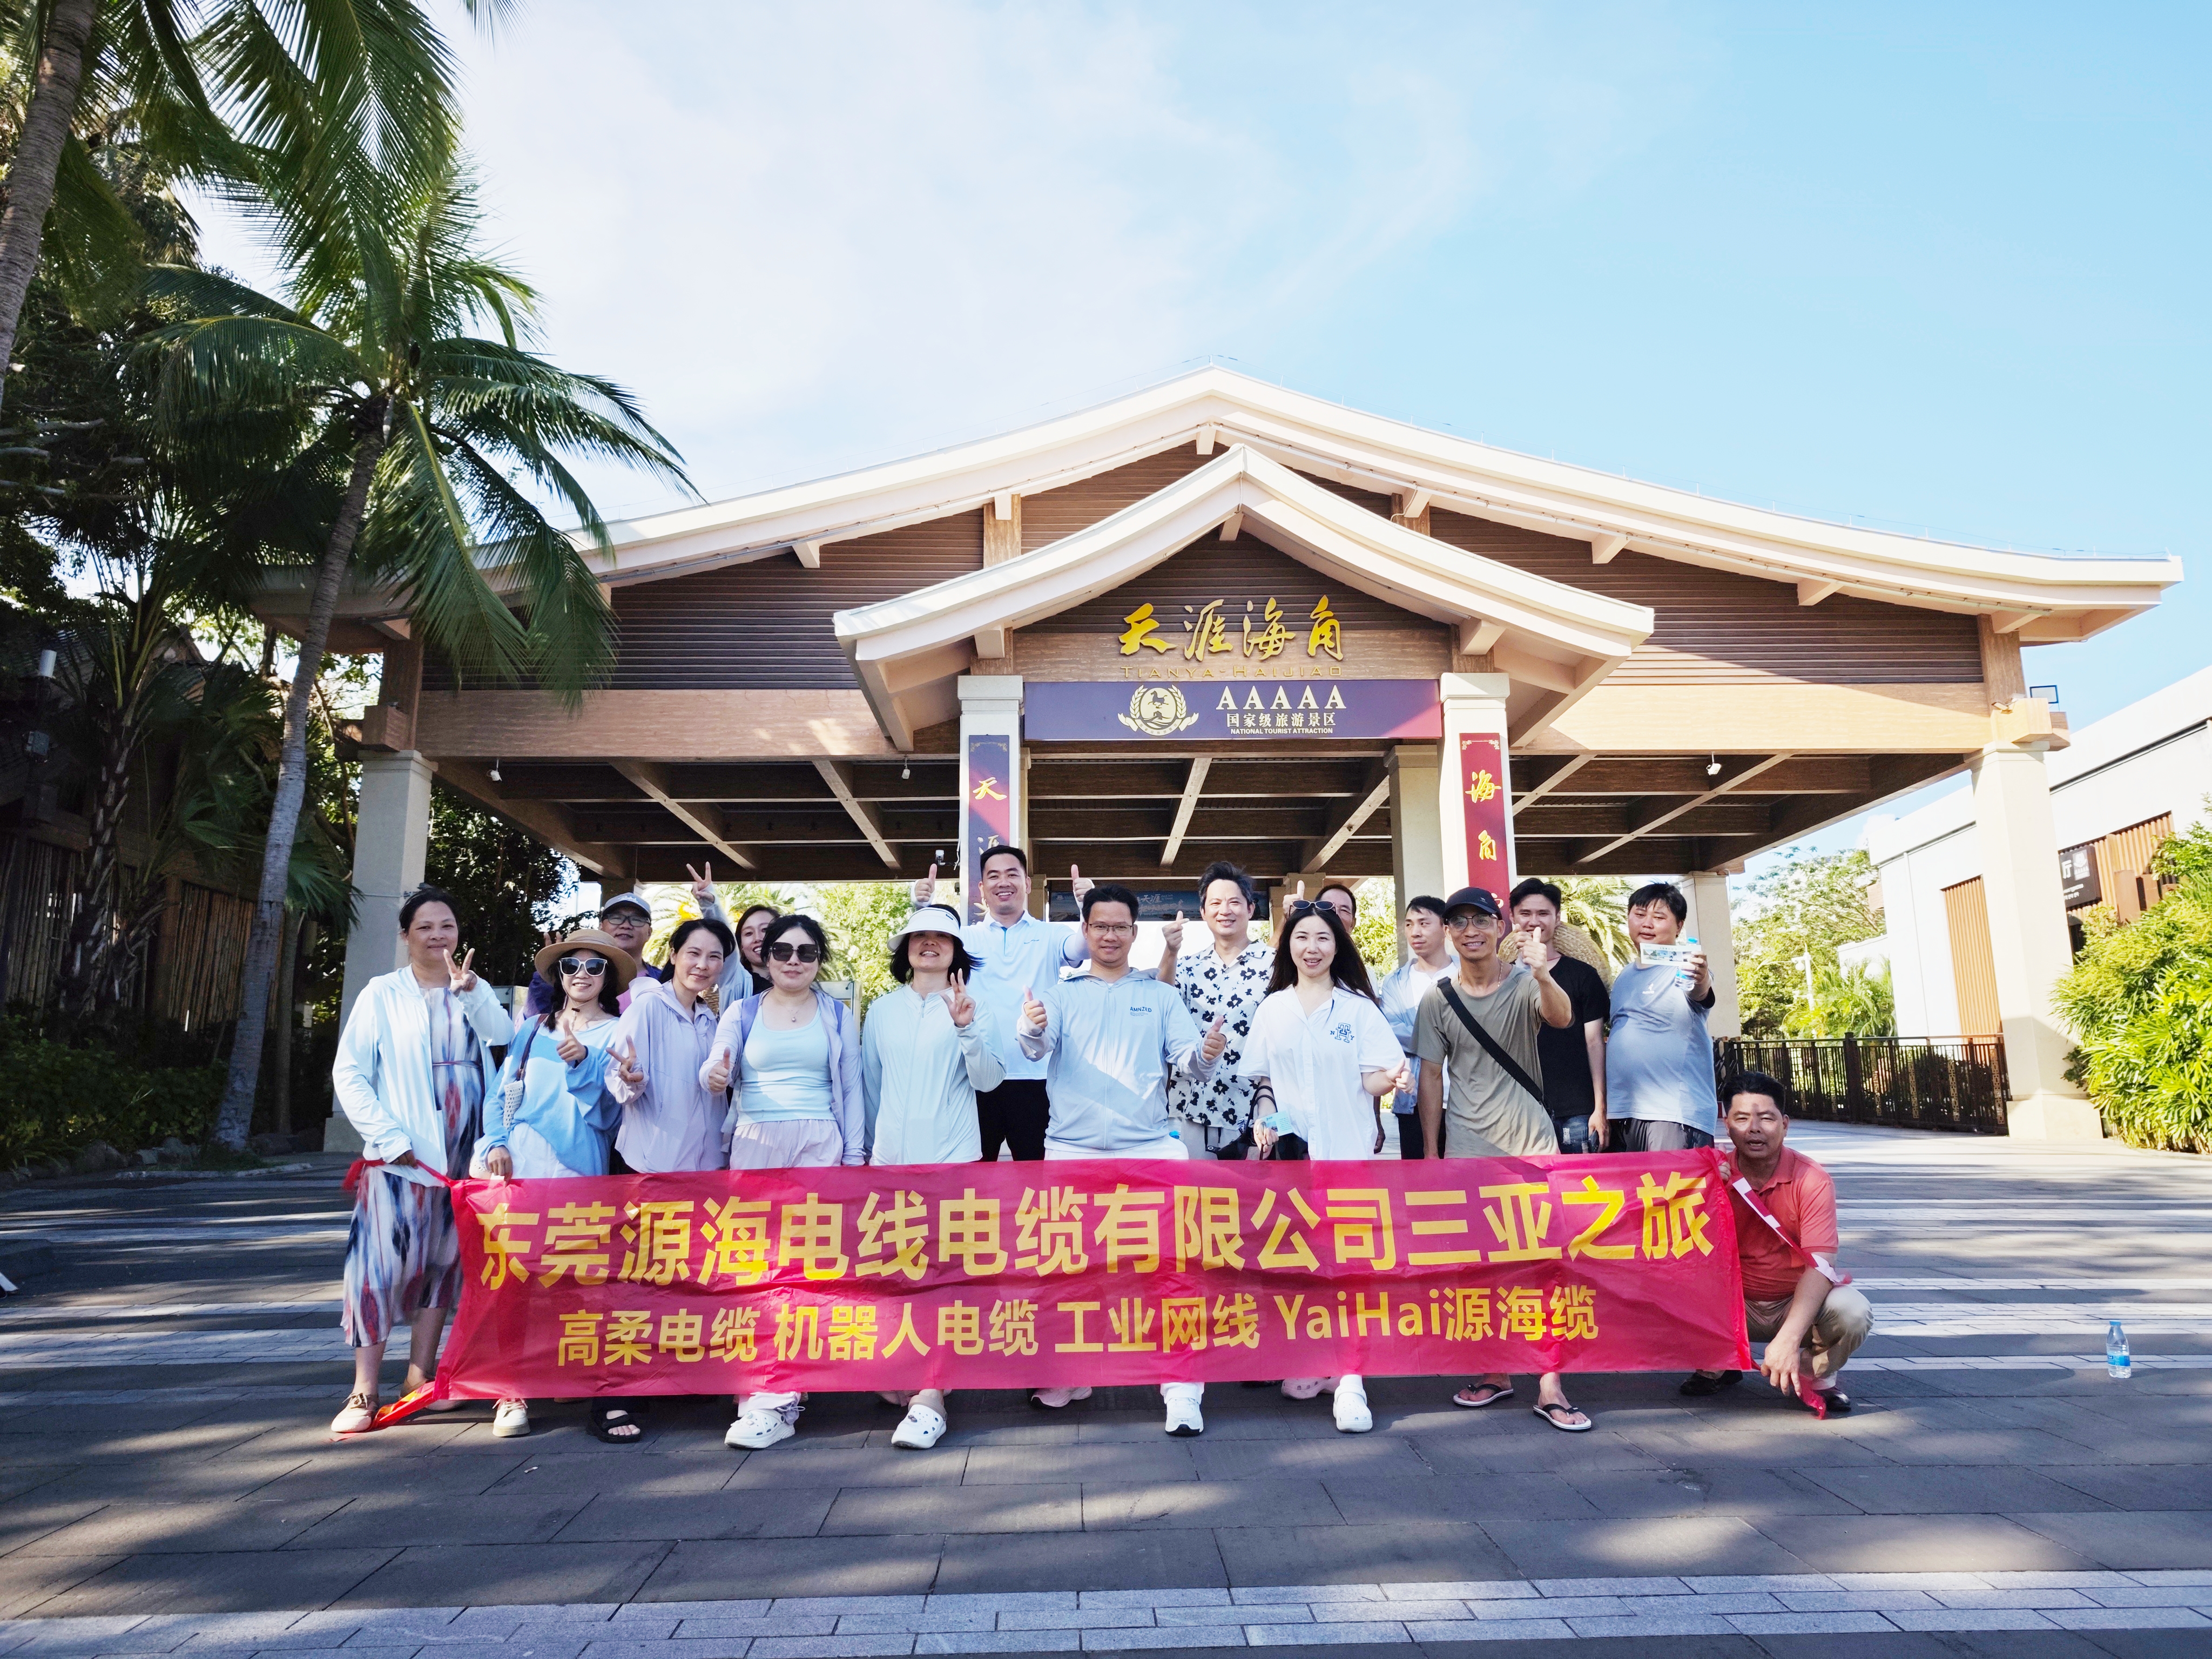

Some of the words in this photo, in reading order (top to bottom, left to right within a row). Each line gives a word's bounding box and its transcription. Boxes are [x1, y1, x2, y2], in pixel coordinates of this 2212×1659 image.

[1118, 595, 1344, 662] 天涯海角
[1216, 685, 1347, 710] AAAAA
[1226, 712, 1336, 727] 国家级旅游景区
[475, 1171, 1714, 1290] 东莞源海电线电缆有限公司三亚之旅
[557, 1307, 760, 1367] 高柔电缆
[773, 1298, 1039, 1362] 机器人电缆
[1054, 1293, 1260, 1353] 工业网线
